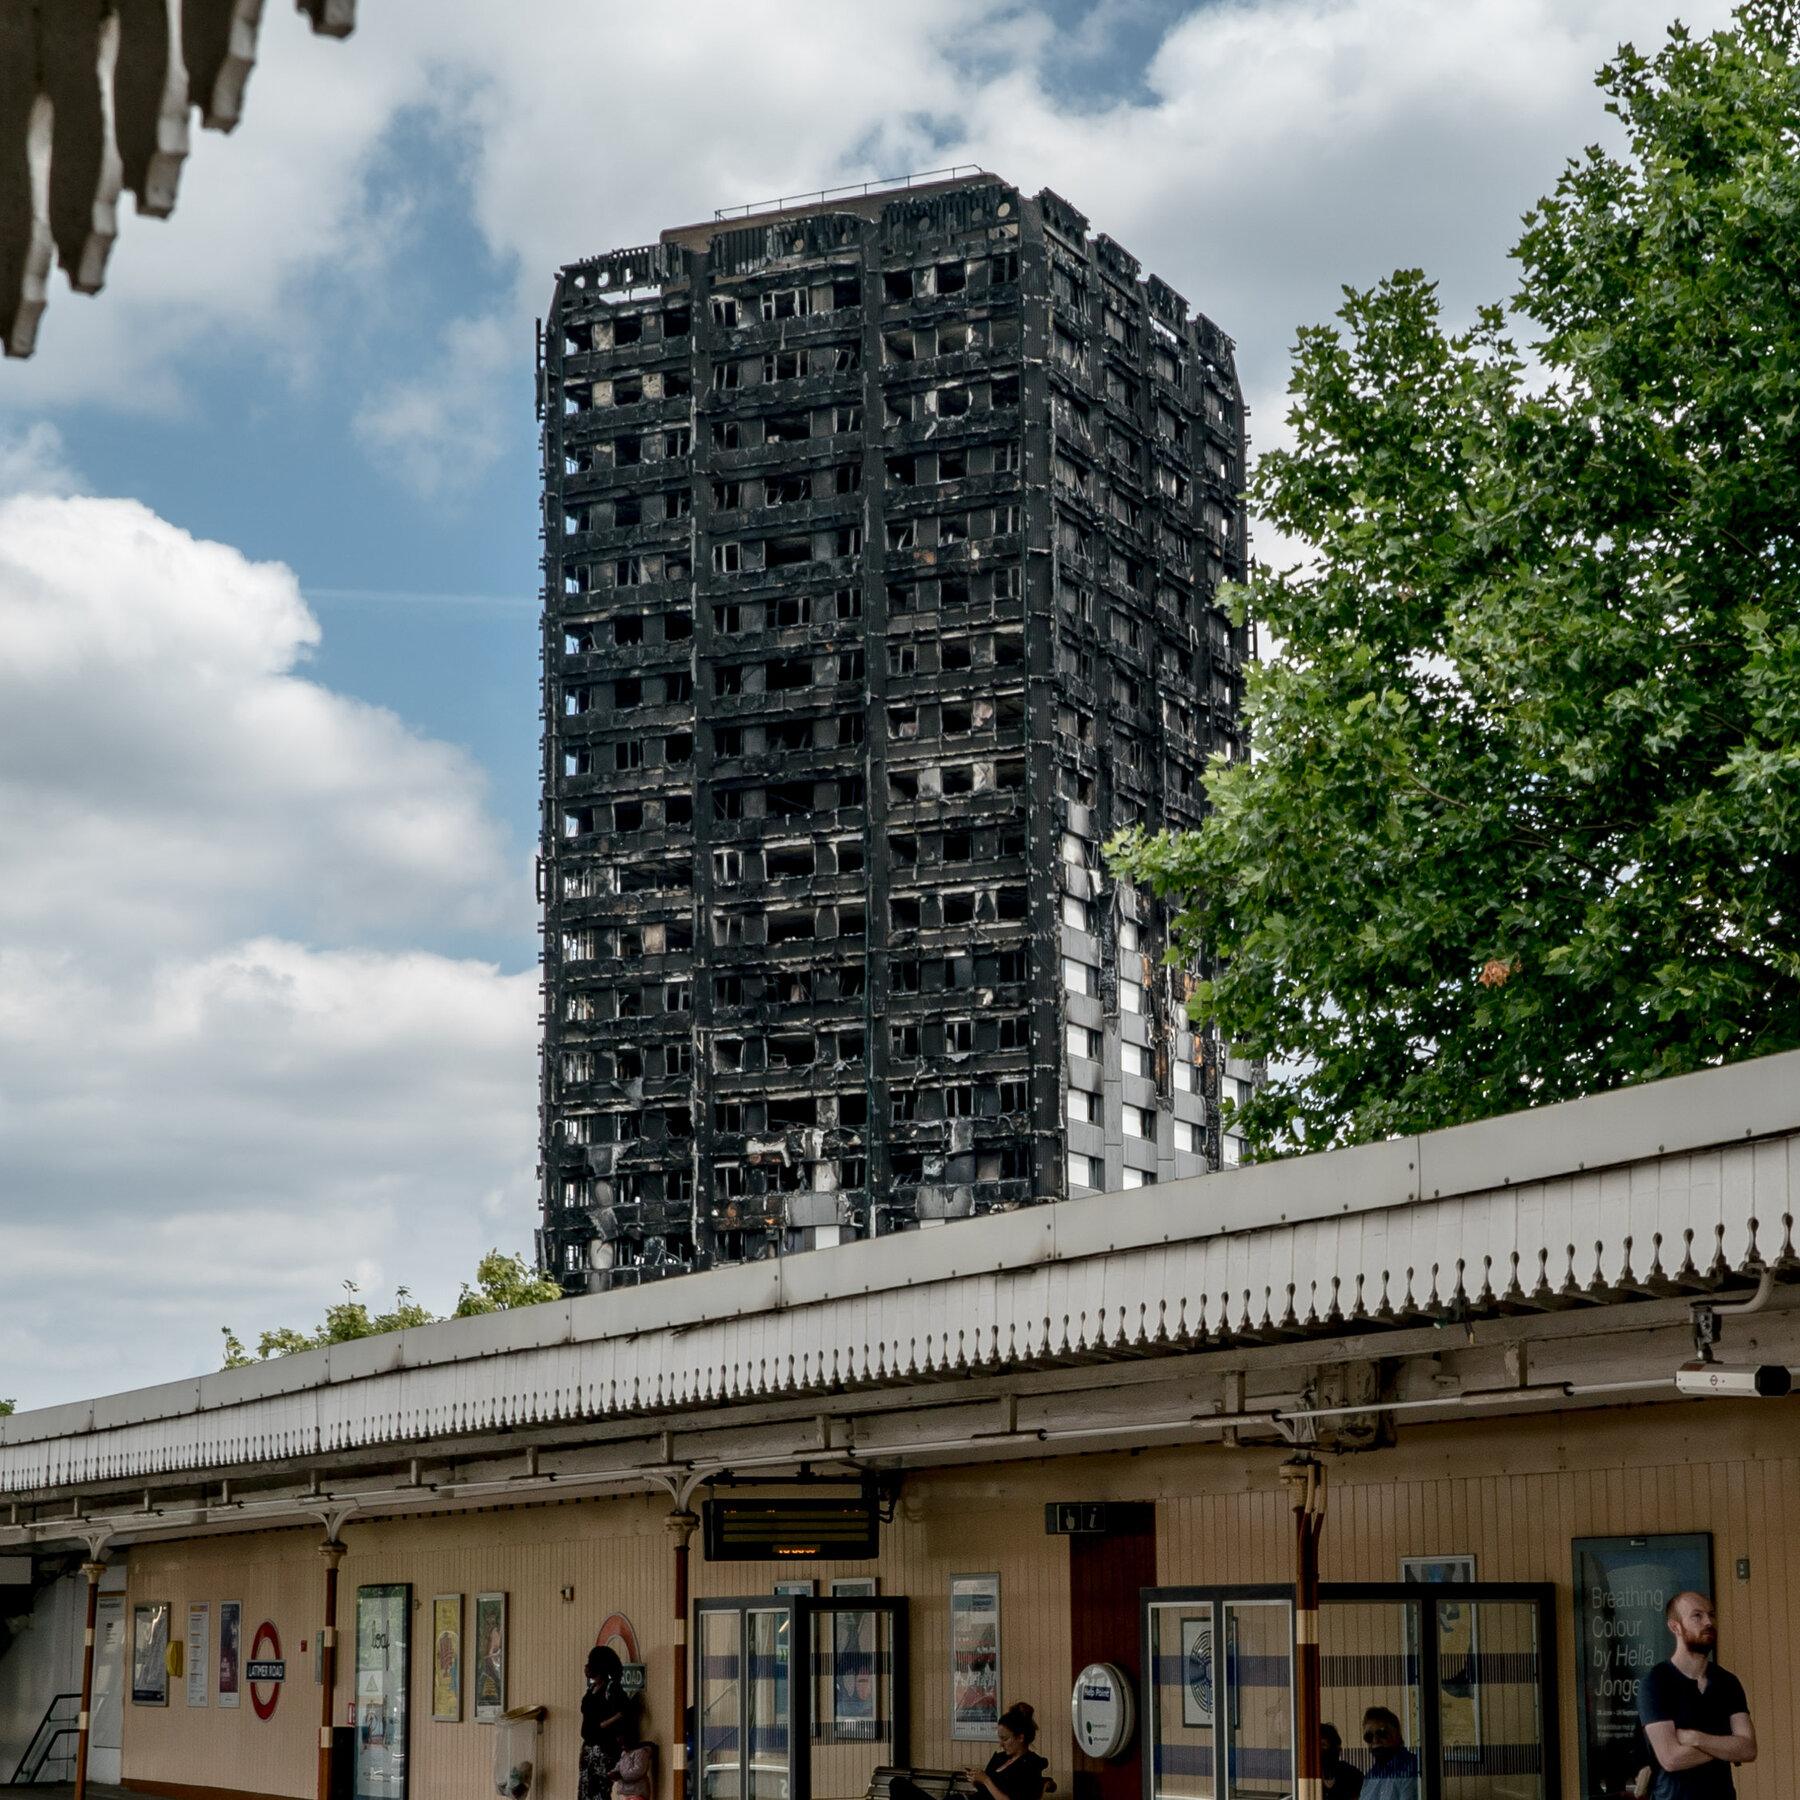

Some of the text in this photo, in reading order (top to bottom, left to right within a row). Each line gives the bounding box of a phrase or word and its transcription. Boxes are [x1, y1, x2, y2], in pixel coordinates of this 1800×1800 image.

[1592, 1585, 1664, 1612] Breathing
[1592, 1615, 1642, 1638] Colour
[269, 1665, 283, 1677] ROAD
[1593, 1644, 1654, 1672] by Hella
[1594, 1674, 1641, 1702] Jonge
